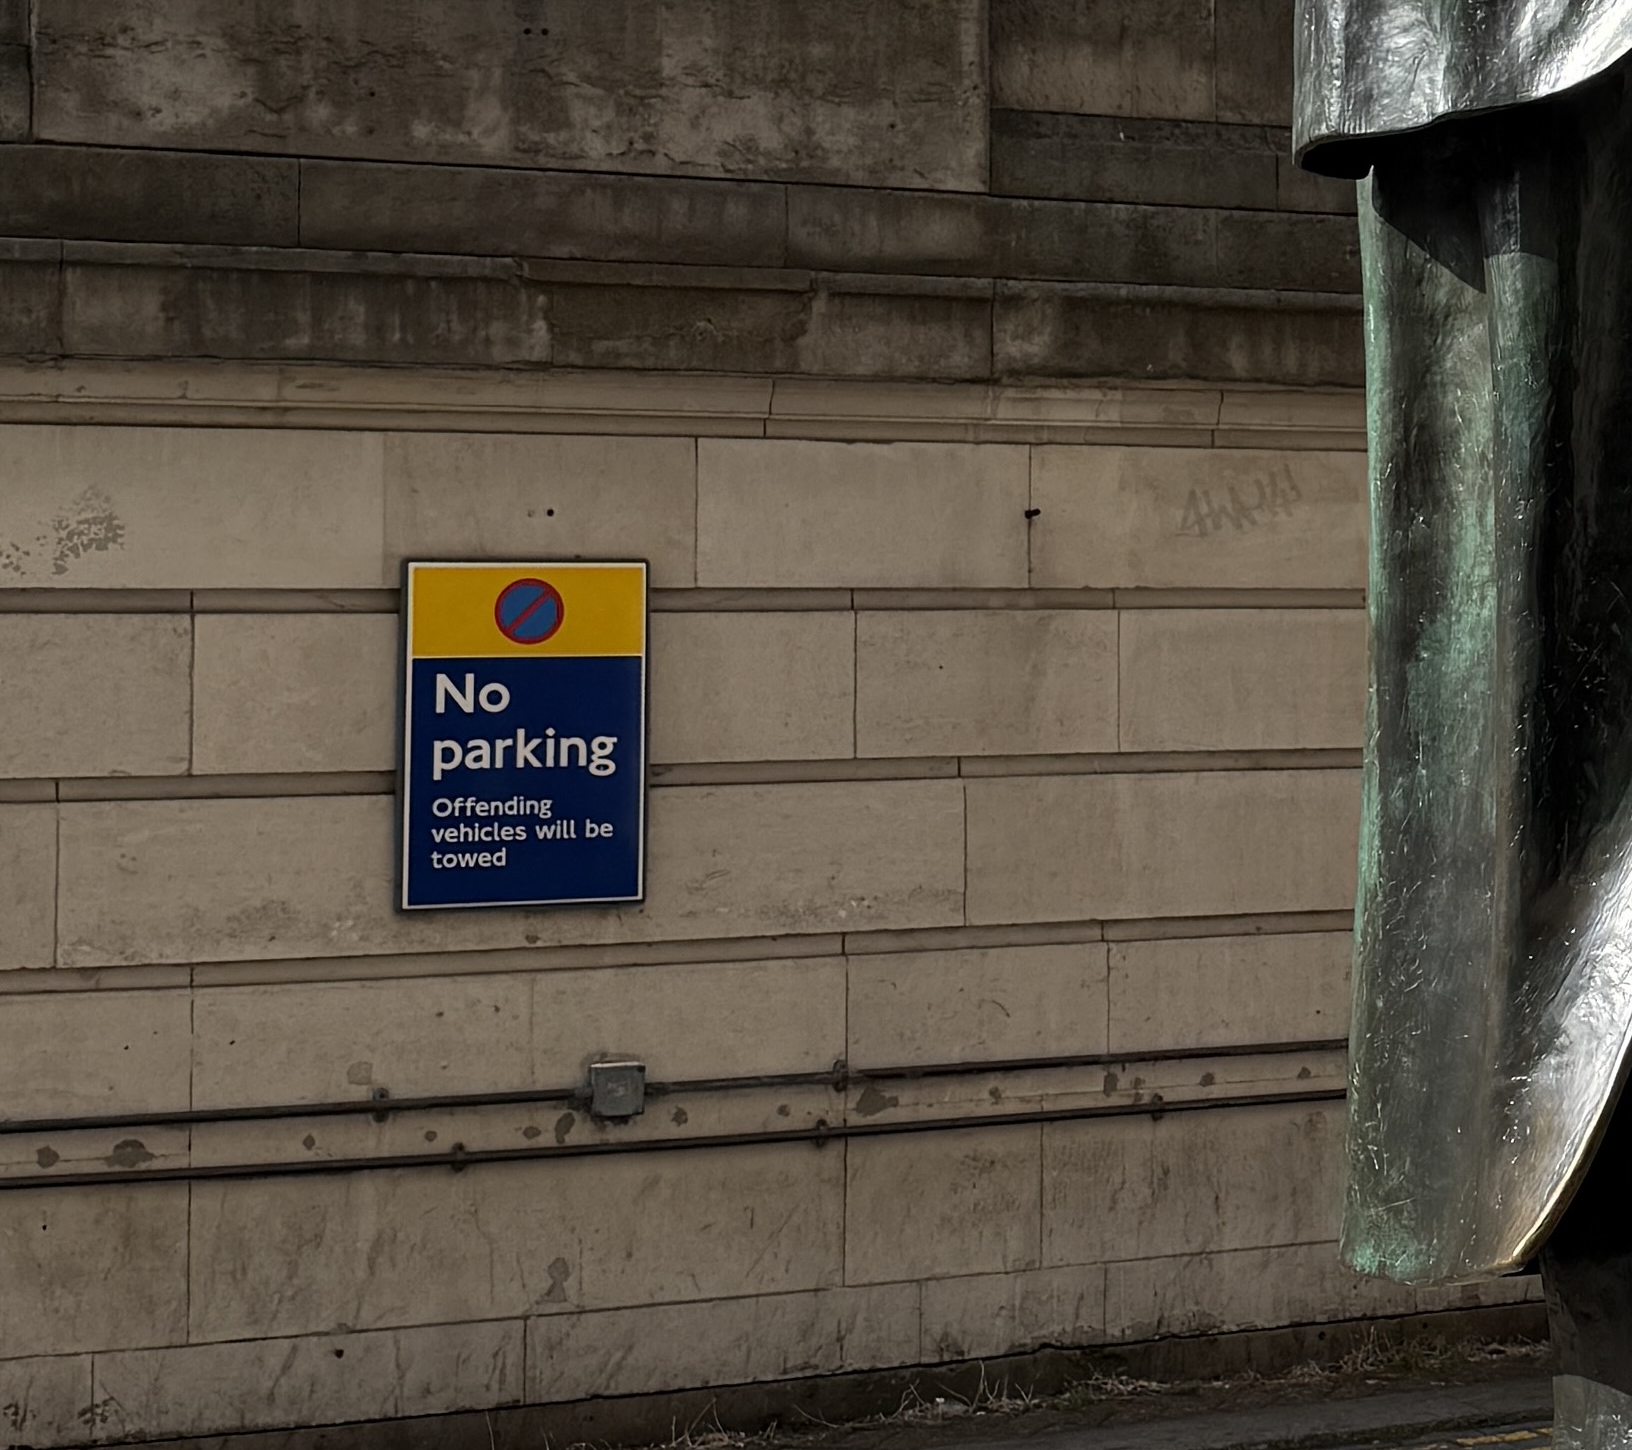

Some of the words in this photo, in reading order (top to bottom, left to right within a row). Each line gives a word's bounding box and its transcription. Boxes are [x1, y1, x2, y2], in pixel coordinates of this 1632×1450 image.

[435, 673, 511, 714] No
[432, 727, 618, 781] parking
[432, 796, 553, 818] Offending
[431, 821, 527, 843] vehicles
[535, 820, 577, 840] will
[585, 819, 614, 838] be
[431, 848, 507, 869] towed
